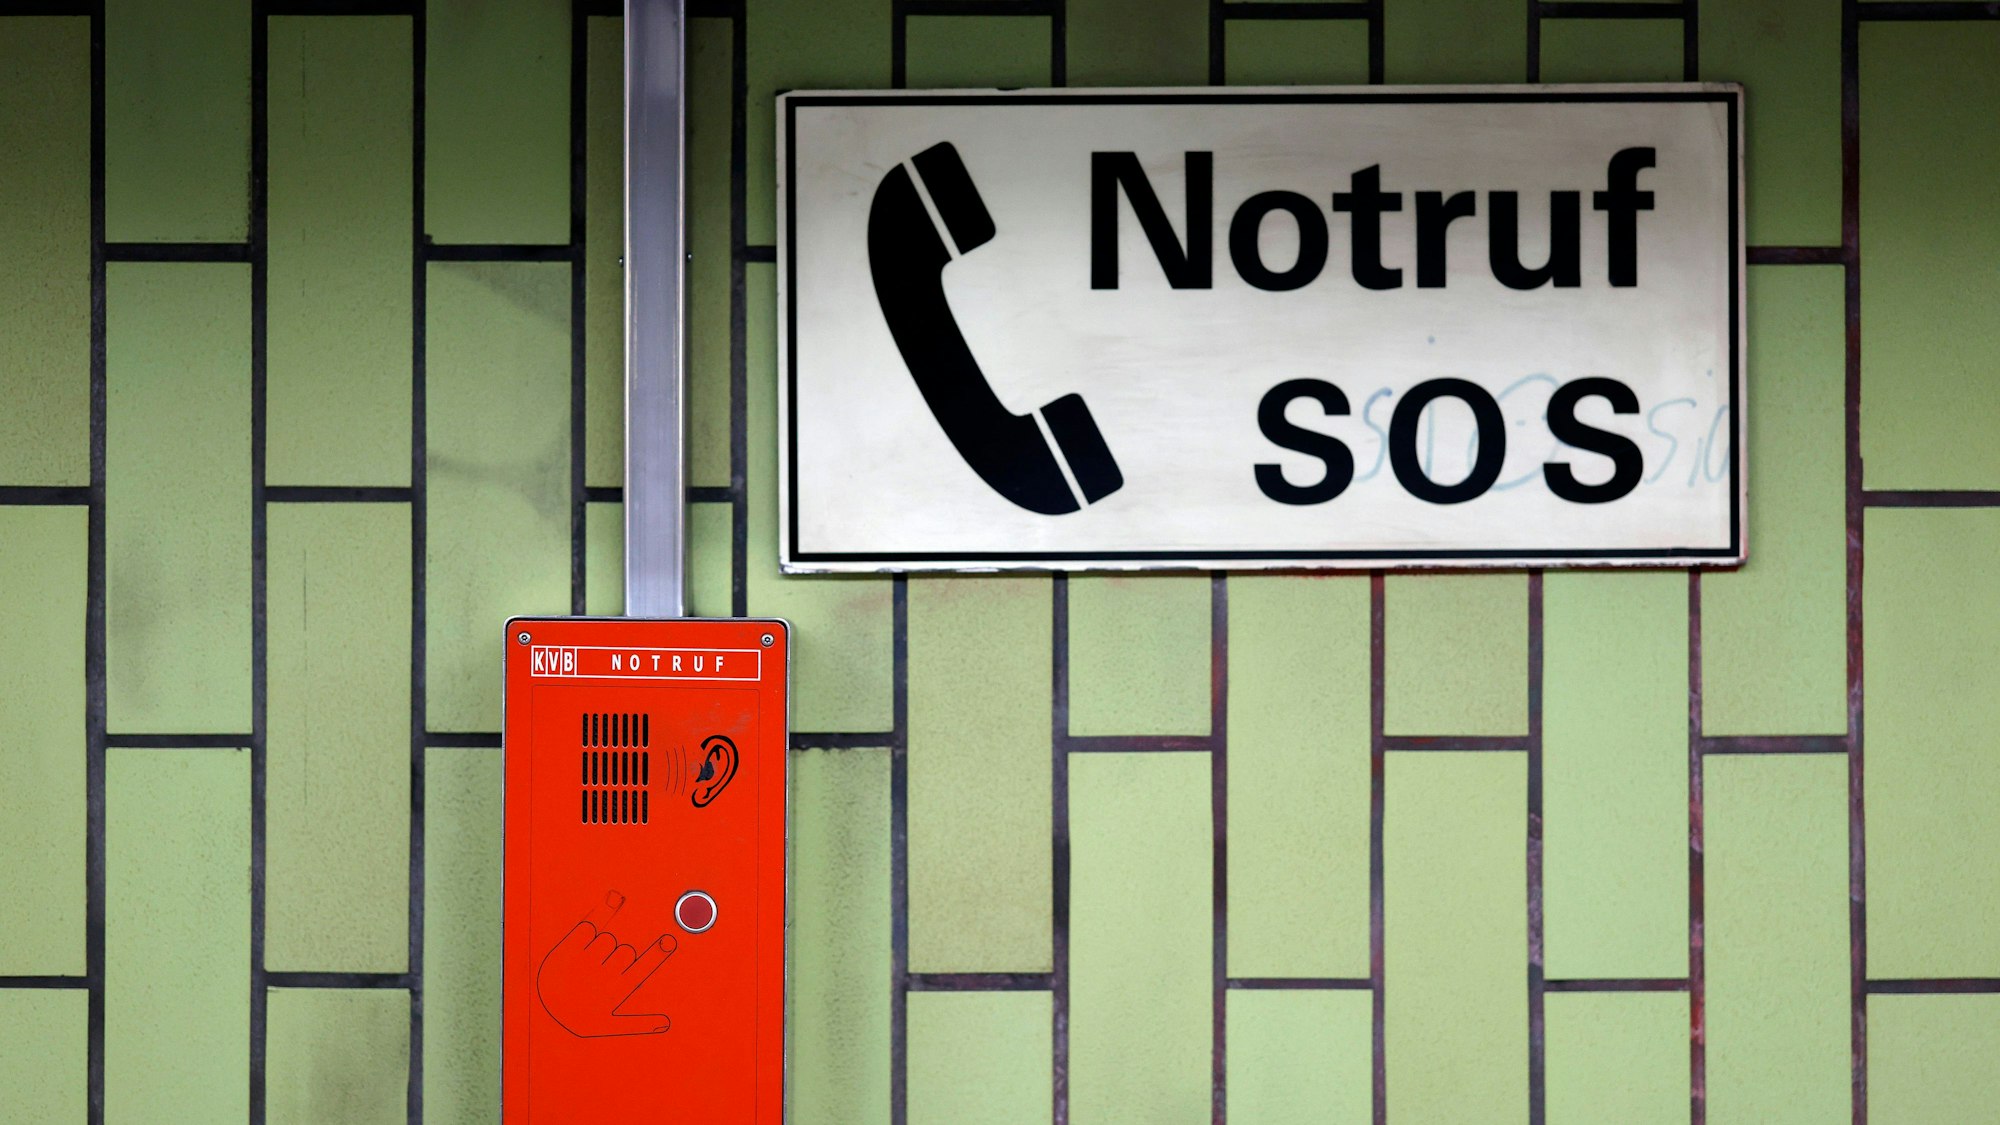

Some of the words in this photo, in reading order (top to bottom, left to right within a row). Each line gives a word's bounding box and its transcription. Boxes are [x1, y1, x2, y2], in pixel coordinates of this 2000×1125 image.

[1090, 146, 1656, 291] Notruf
[1254, 377, 1644, 505] SOS
[533, 651, 575, 673] KVB
[611, 654, 725, 673] NOTRUF
